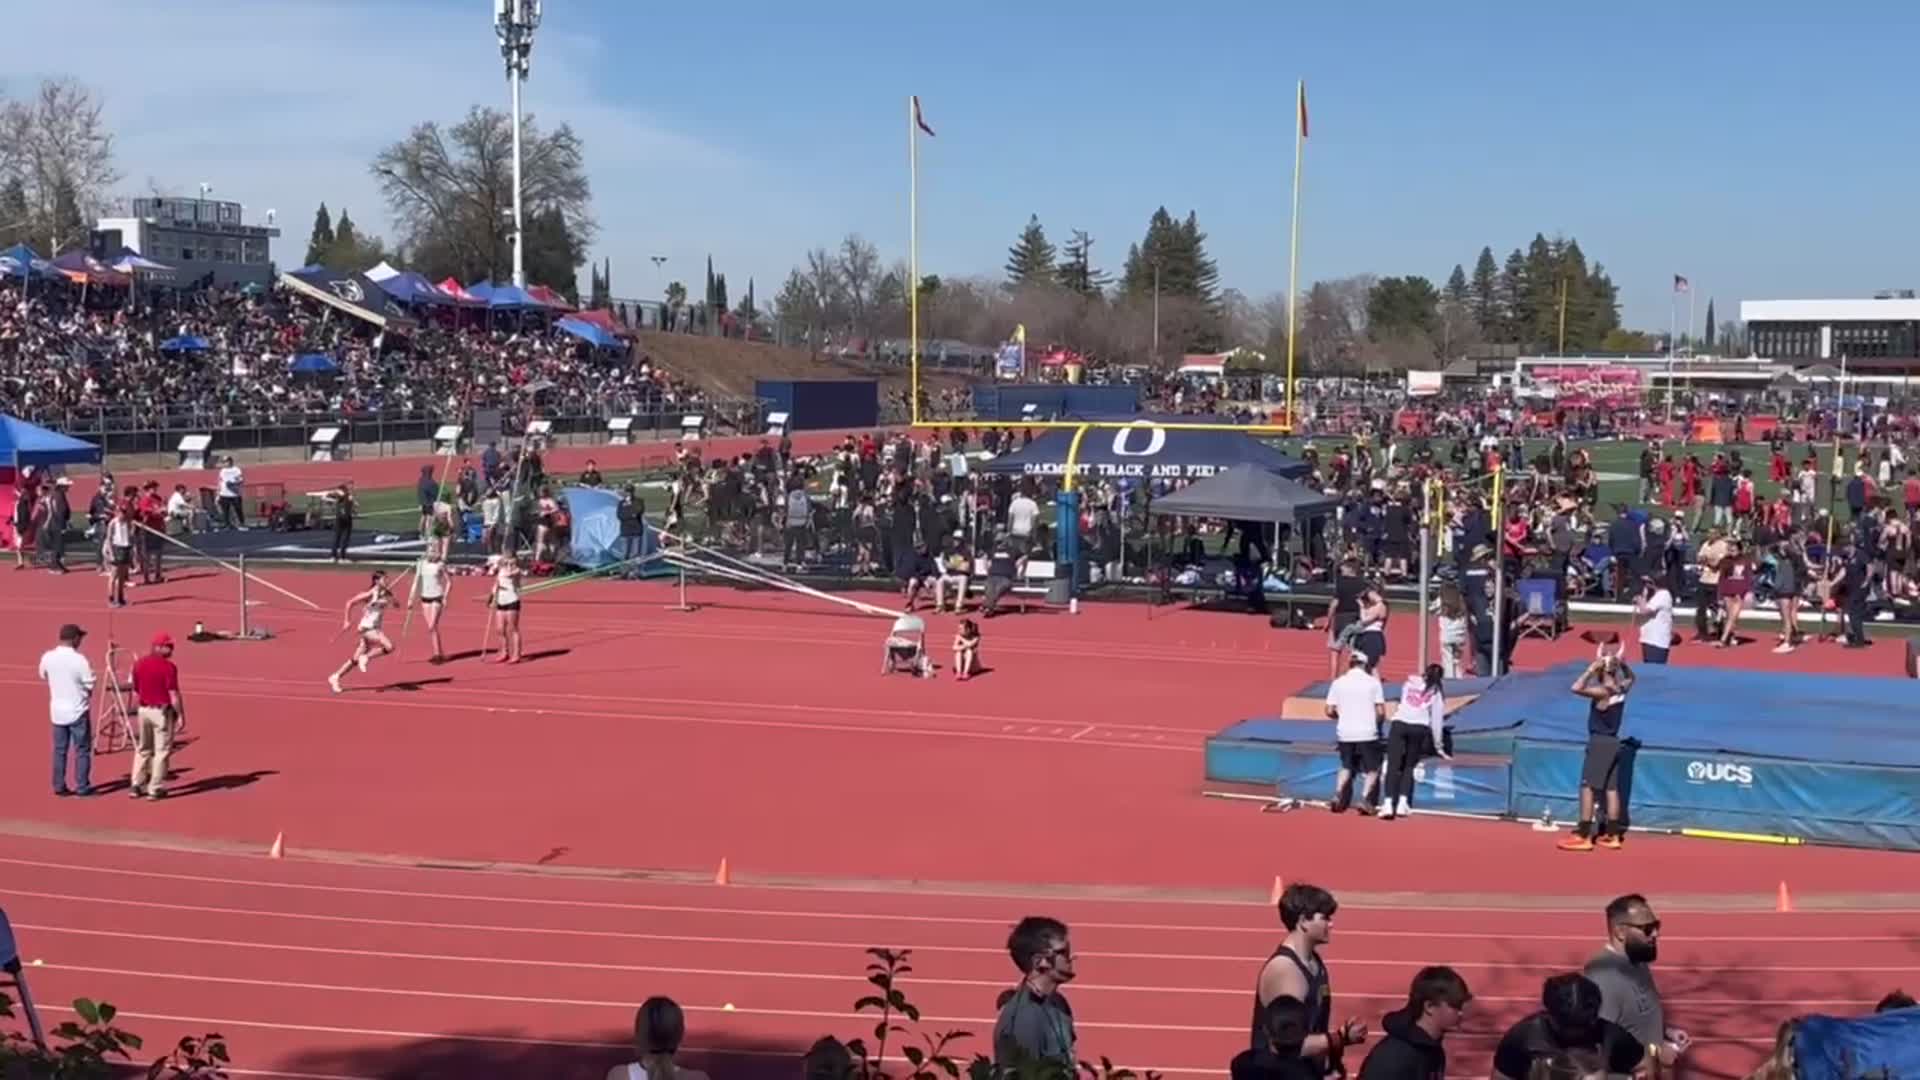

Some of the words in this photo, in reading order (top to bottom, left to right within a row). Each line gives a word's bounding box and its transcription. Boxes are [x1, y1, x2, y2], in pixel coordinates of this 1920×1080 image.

[1112, 419, 1166, 456] O
[1024, 463, 1091, 475] OAKMNT
[1098, 463, 1144, 476] TRACK
[1152, 464, 1180, 476] AND
[1705, 762, 1753, 783] UCS
